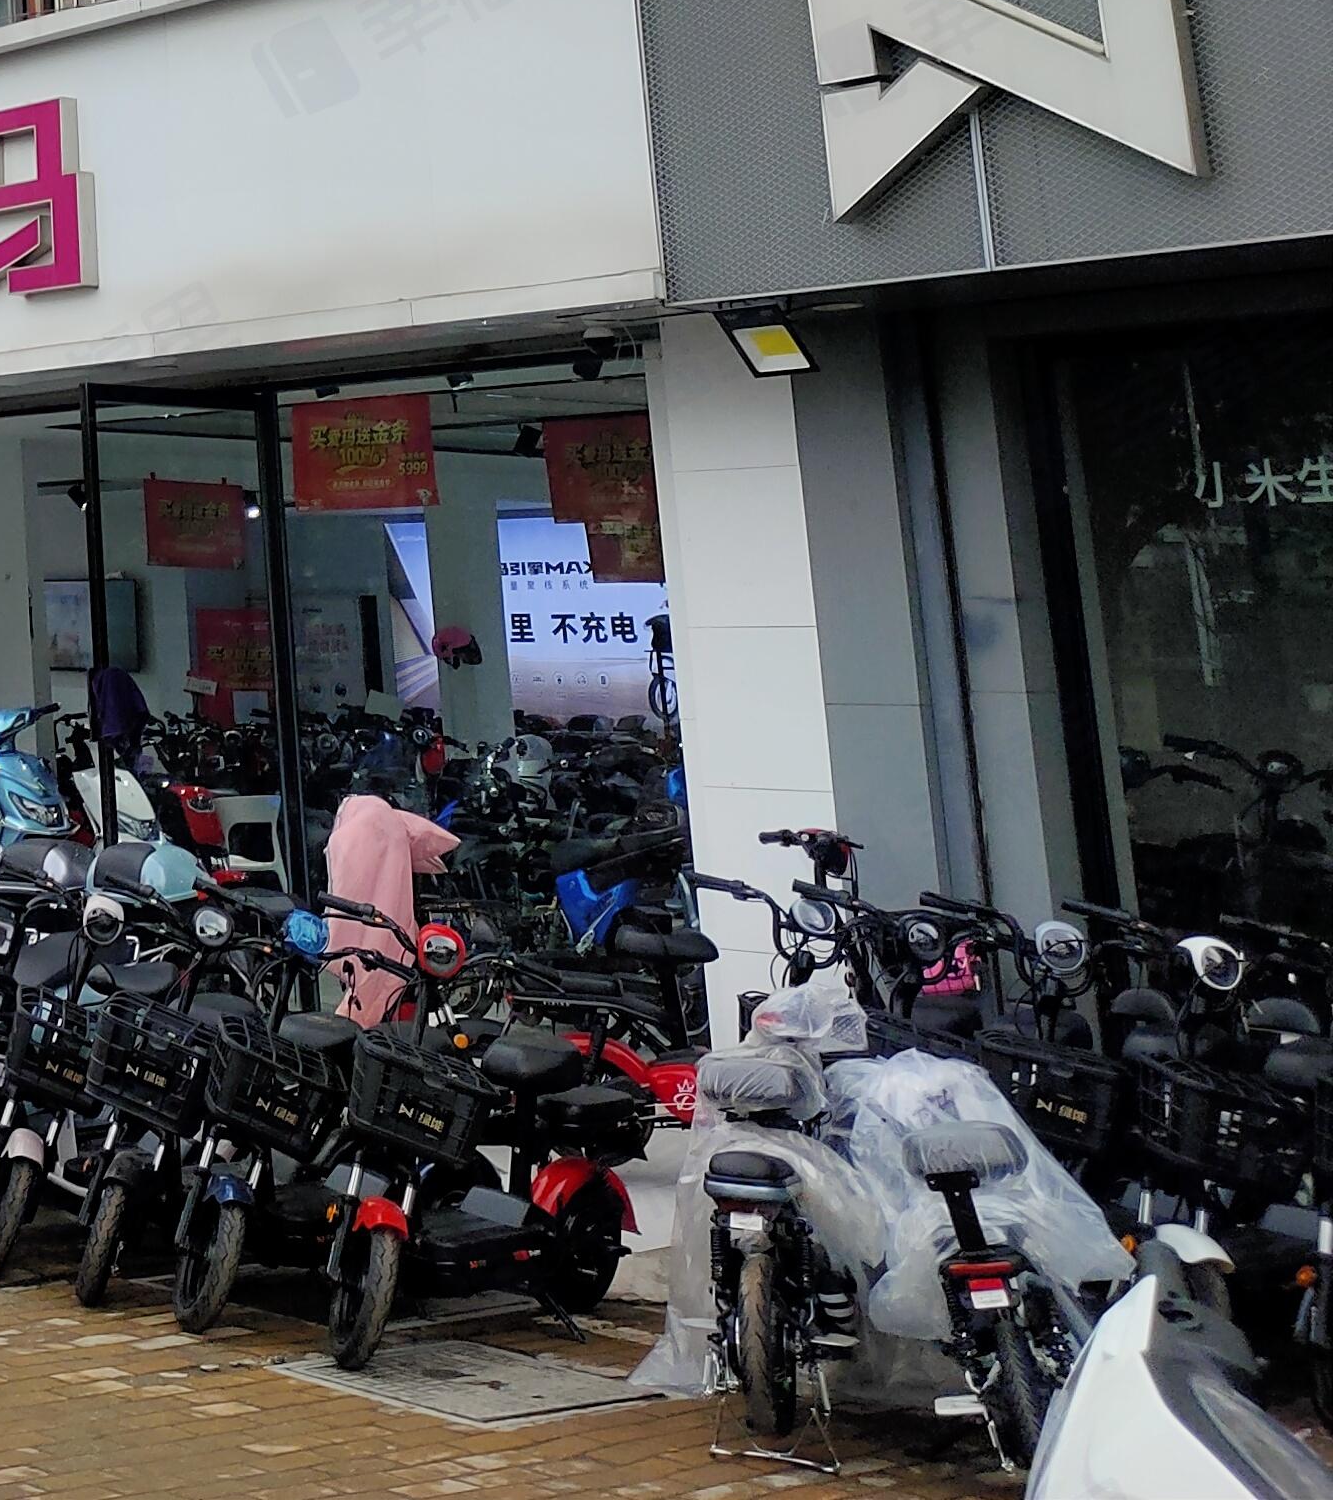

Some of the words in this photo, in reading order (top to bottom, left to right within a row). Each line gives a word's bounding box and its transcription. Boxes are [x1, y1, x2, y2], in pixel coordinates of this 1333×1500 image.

[398, 460, 429, 477] 5999
[510, 613, 535, 643] 里
[550, 611, 638, 644] 不充电
